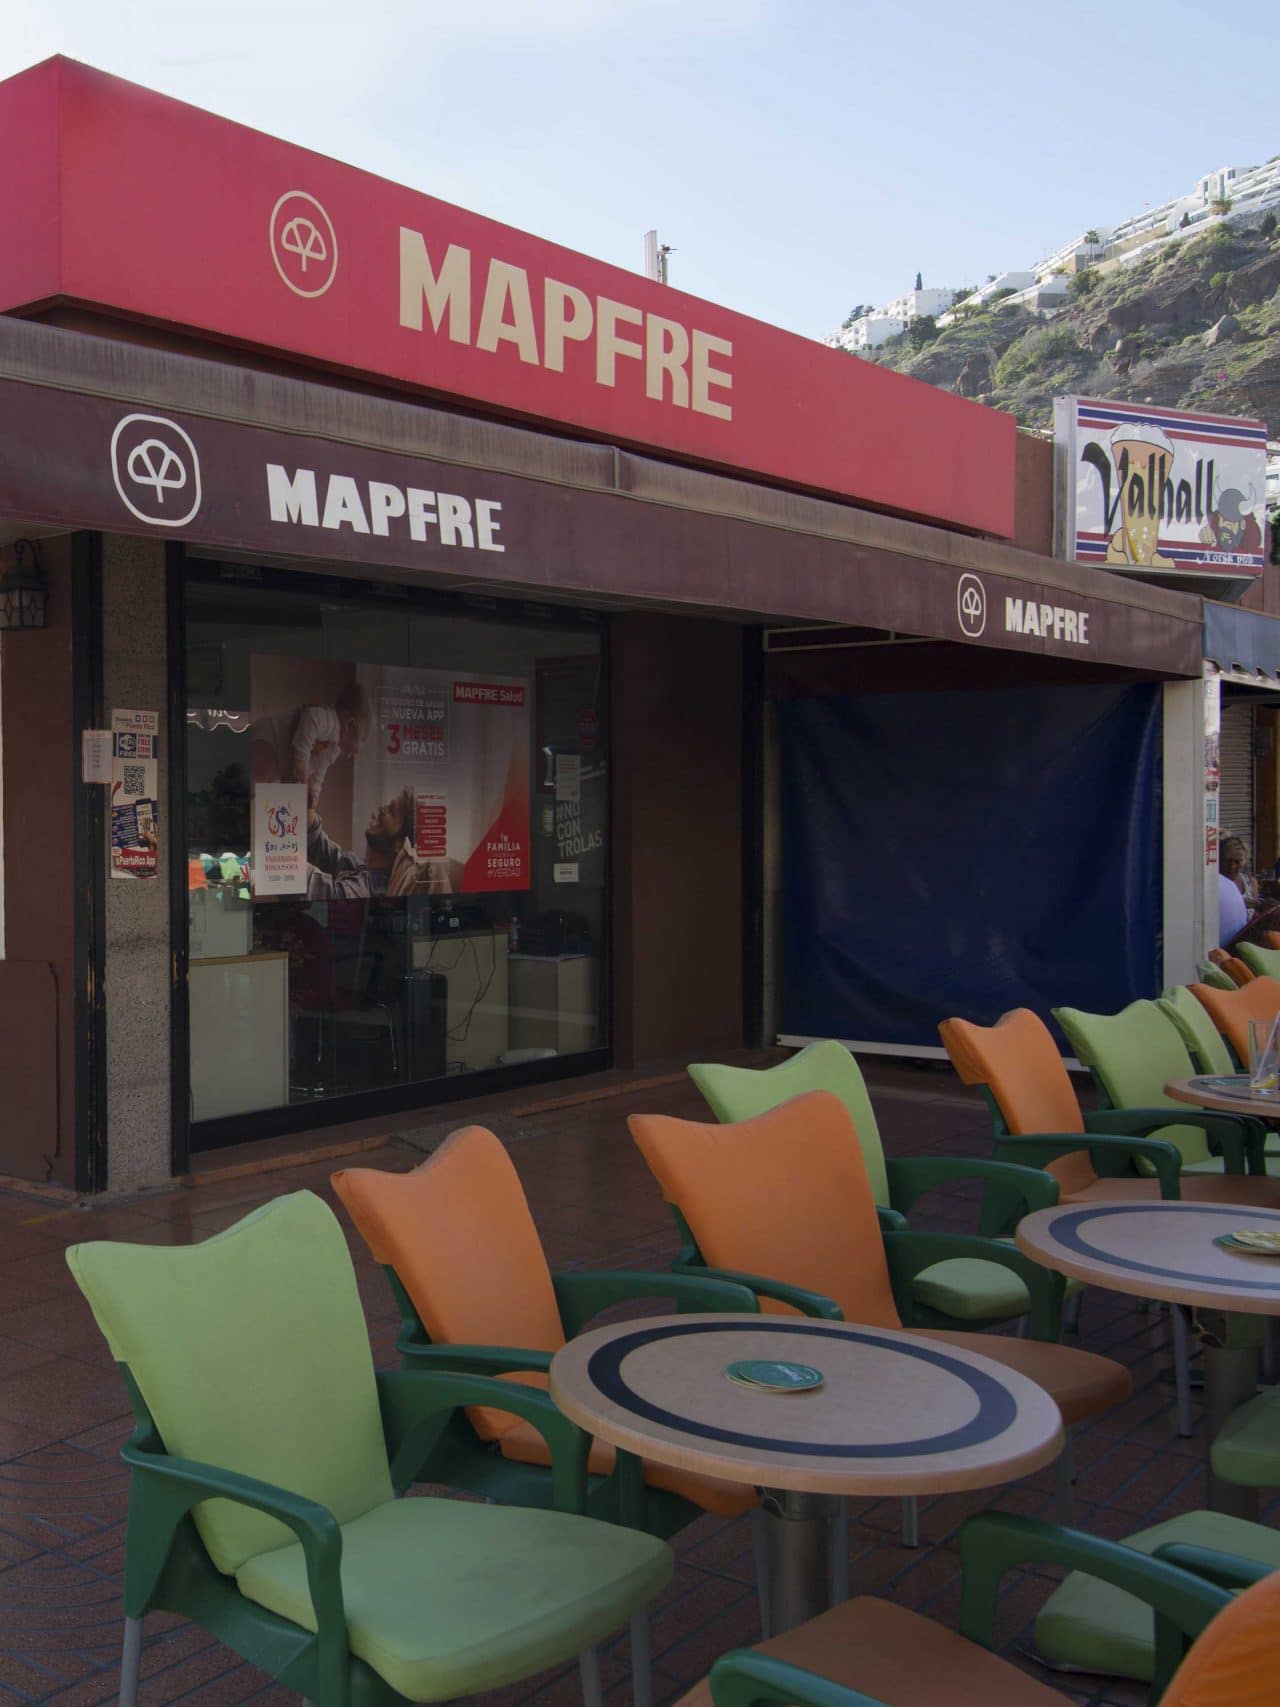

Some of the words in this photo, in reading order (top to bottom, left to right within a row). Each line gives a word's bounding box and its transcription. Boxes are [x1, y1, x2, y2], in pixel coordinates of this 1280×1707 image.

[399, 226, 733, 422] MAPFRE
[1081, 442, 1215, 538] Valhall
[266, 463, 505, 552] MAPFRE
[1005, 597, 1089, 645] MAPFRE
[455, 685, 498, 701] MAPFRE
[500, 689, 523, 704] Salud
[391, 706, 424, 720] NUEVA
[426, 708, 445, 721] APP
[387, 723, 401, 754] 3
[402, 741, 445, 756] GRATIS
[487, 842, 520, 851] FAMILIA
[557, 829, 602, 858] TROLAS
[487, 859, 520, 868] SEGURO
